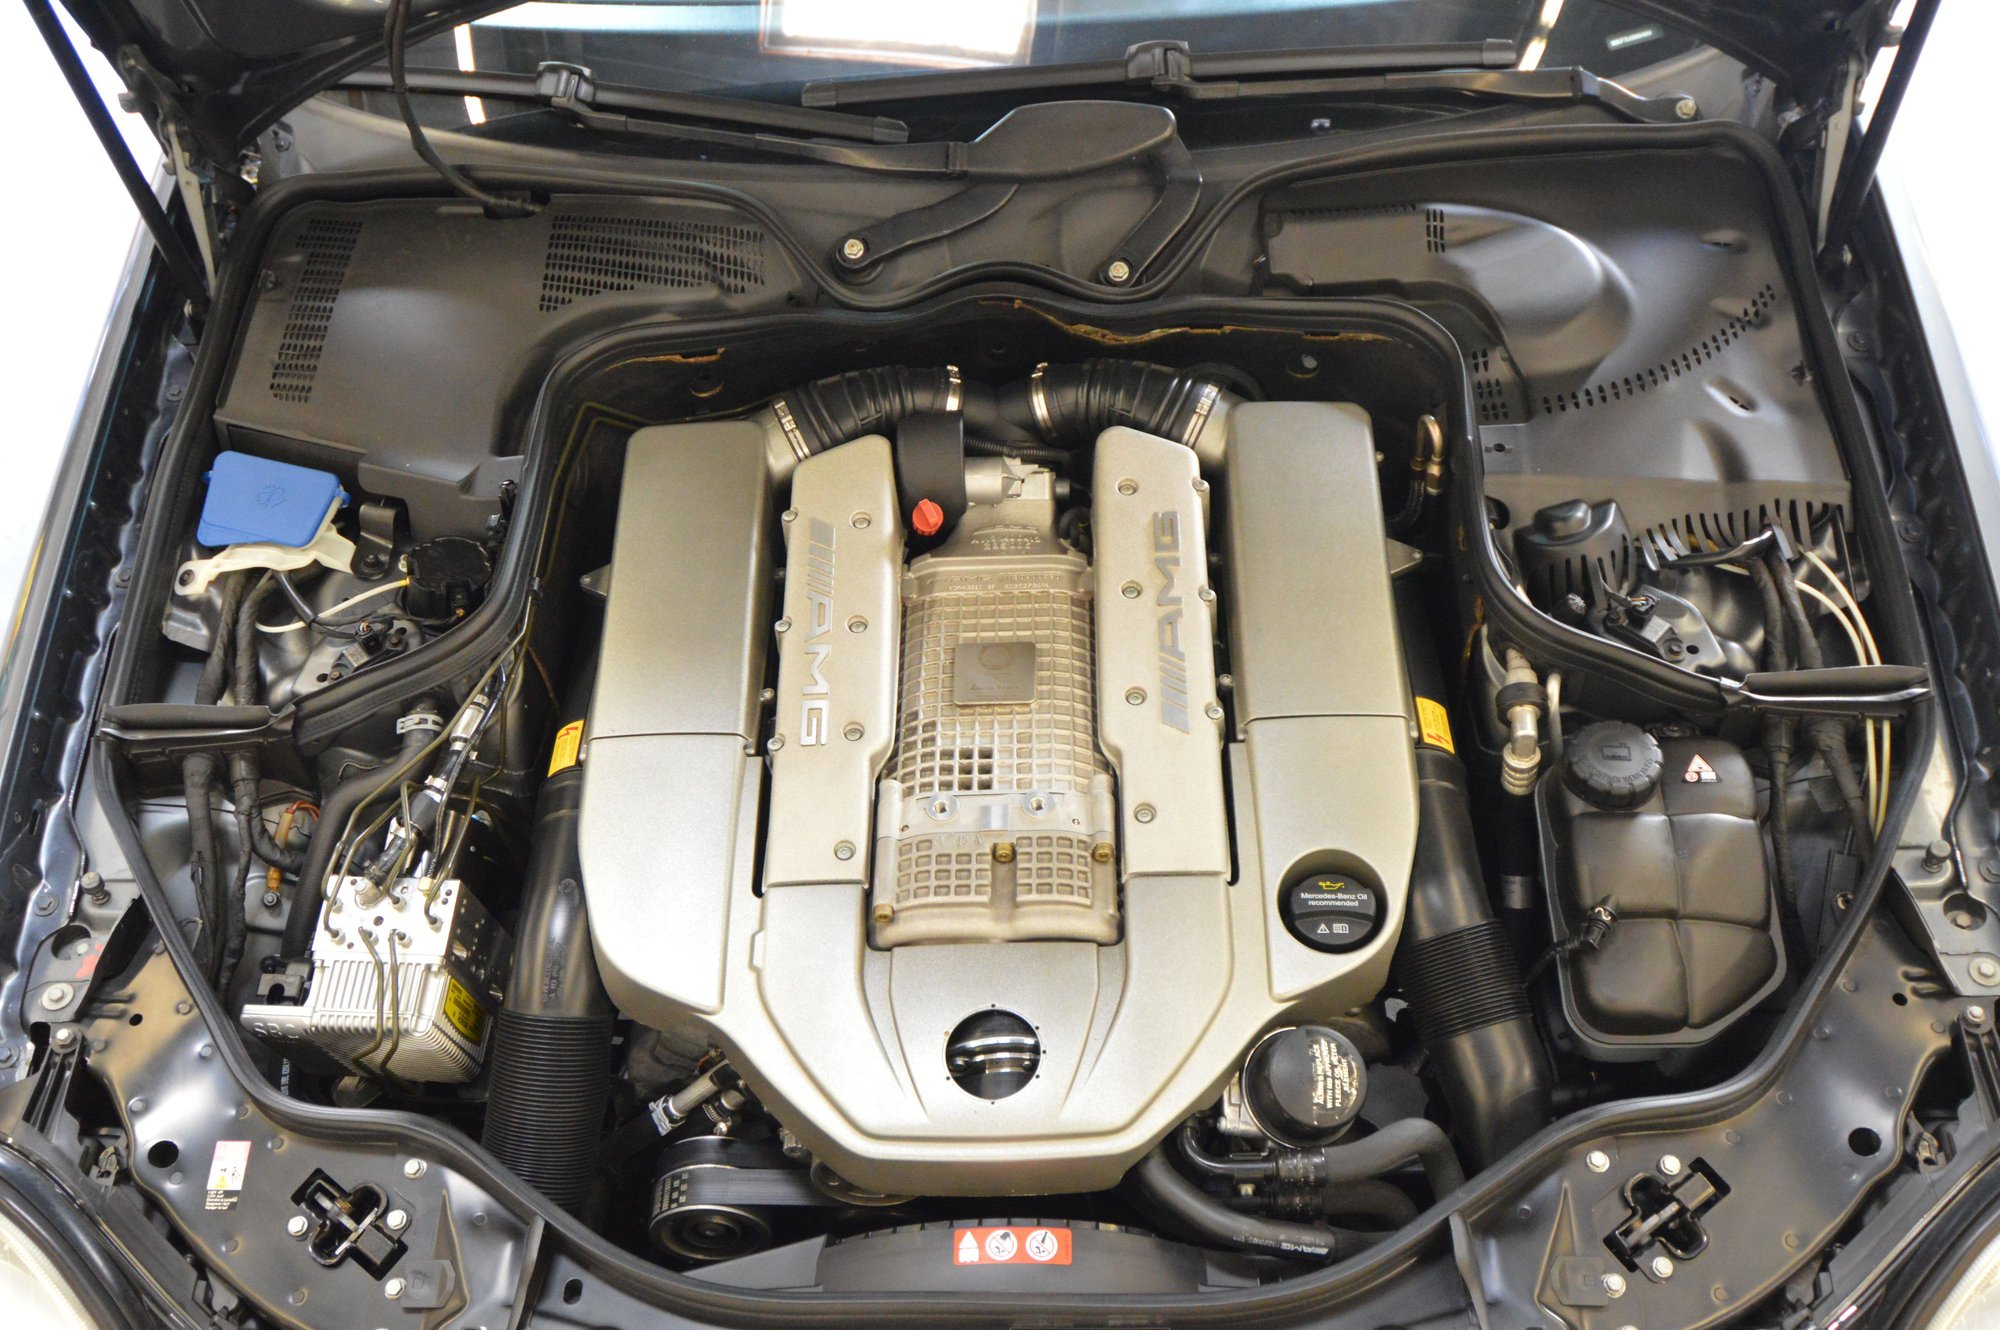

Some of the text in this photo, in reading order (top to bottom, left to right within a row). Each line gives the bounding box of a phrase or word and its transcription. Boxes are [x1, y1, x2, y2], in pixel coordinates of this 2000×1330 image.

[1153, 511, 1185, 663] AMG
[800, 590, 833, 747] AMG
[1300, 892, 1356, 900] Mercedes-Benz
[253, 1022, 299, 1039] SBC
[1313, 1044, 1324, 1074] REPLACE
[1326, 1077, 1333, 1089] MB
[1334, 1079, 1342, 1107] FLEECE
[1326, 1089, 1334, 1109] WITH
[1280, 1242, 1313, 1254] AMG
